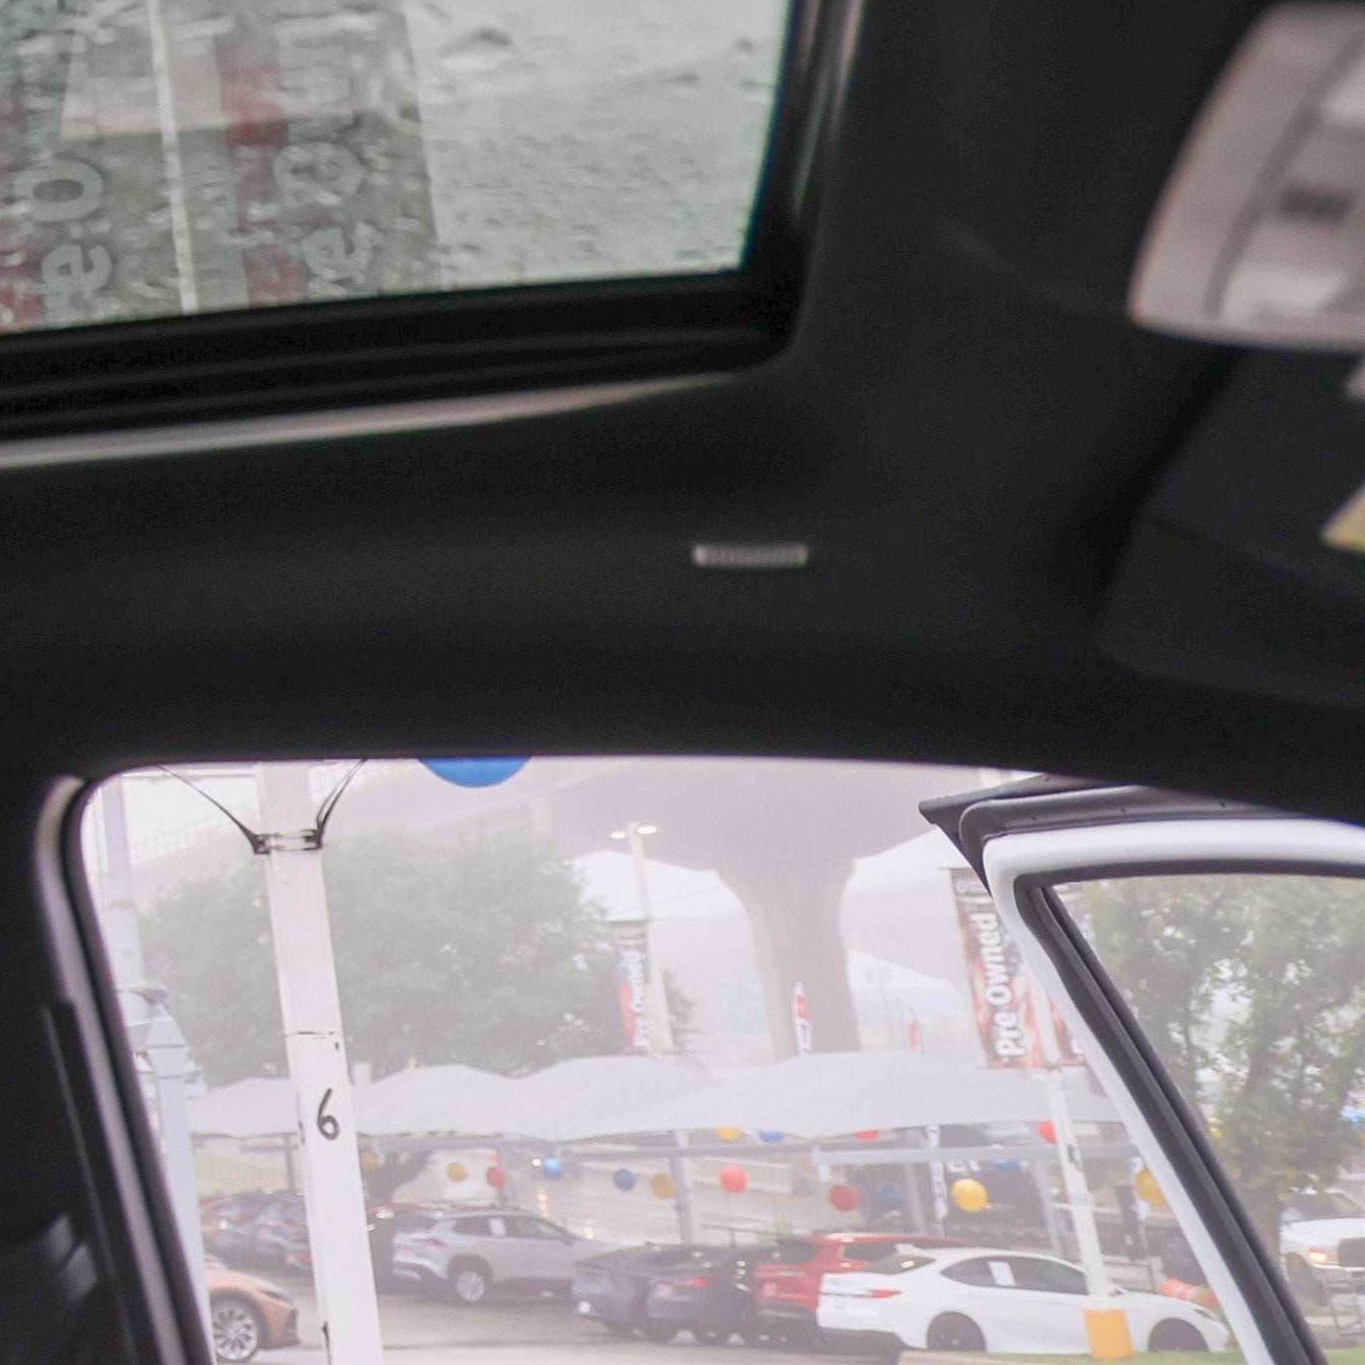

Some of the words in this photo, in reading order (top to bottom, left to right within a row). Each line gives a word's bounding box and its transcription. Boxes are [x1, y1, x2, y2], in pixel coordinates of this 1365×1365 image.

[970, 912, 1014, 1006] Owned
[993, 1010, 1027, 1057] Pre
[317, 1088, 340, 1140] 6
